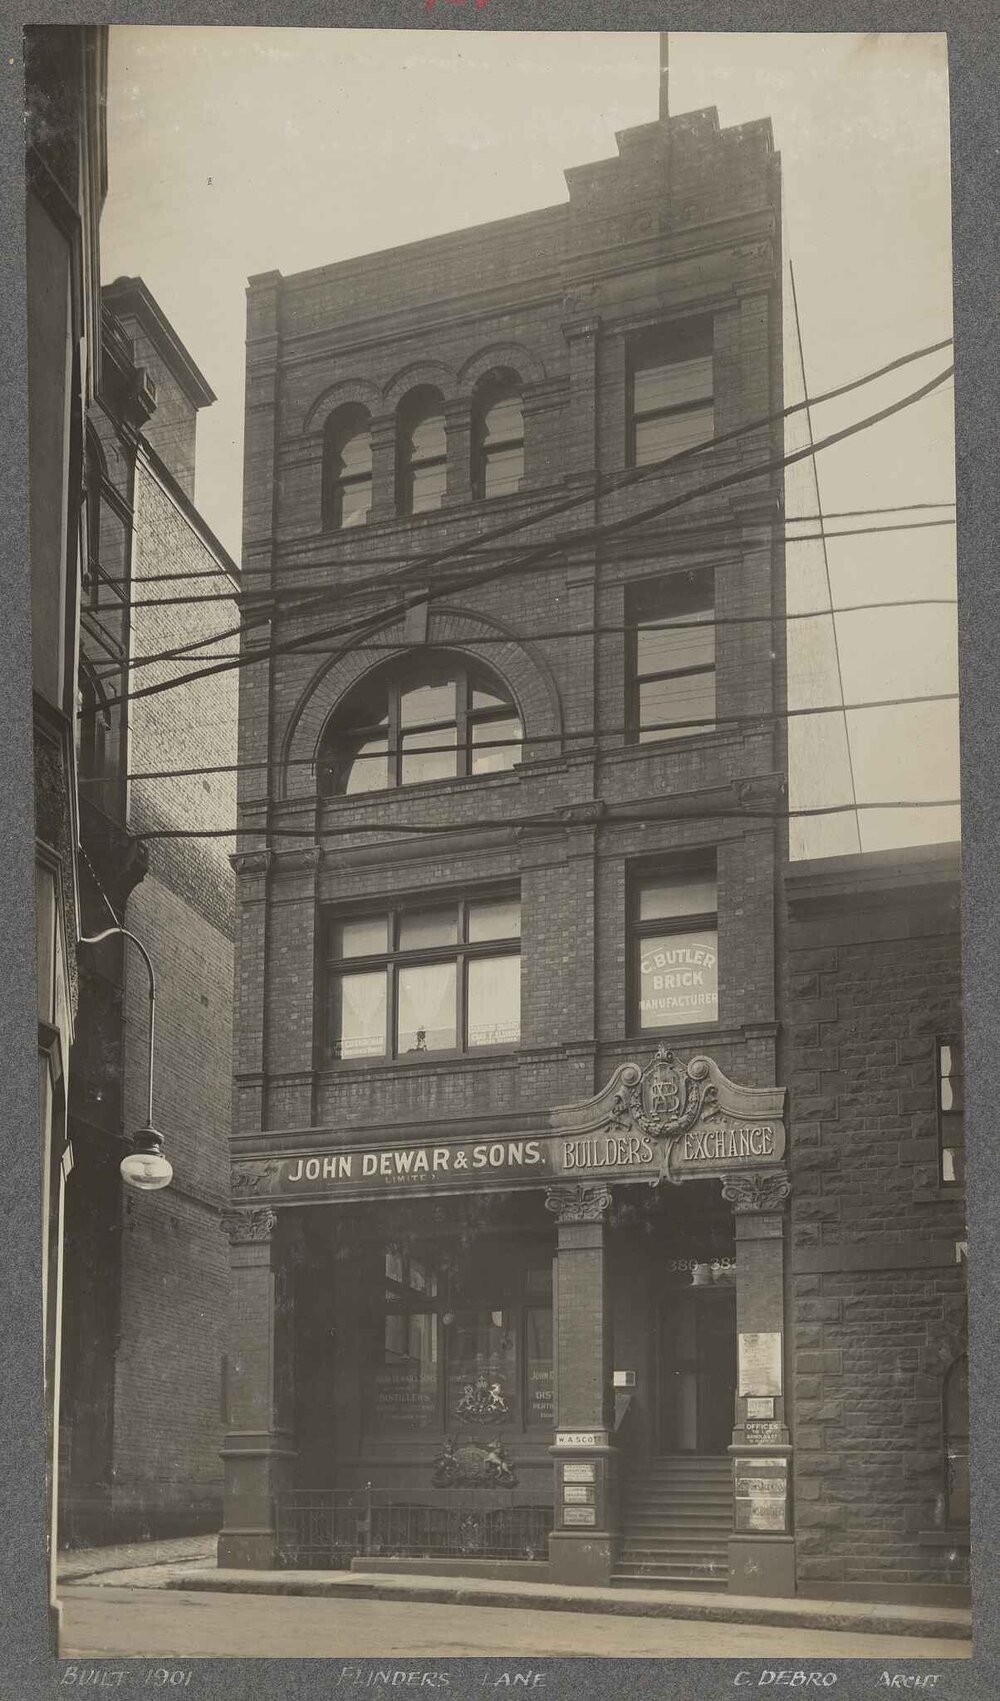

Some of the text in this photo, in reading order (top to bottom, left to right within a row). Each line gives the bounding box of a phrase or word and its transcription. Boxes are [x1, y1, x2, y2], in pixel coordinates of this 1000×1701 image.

[653, 970, 704, 990] BRICK
[639, 993, 718, 1011] MANUFACTURER
[563, 1126, 774, 1169] BUILDERS EXCHANGE
[289, 1156, 352, 1182] JOHN
[362, 1149, 450, 1177] DEWAR
[454, 1152, 468, 1169] &
[60, 1667, 192, 1687] BUILT 1901
[336, 1666, 547, 1689] FLINDERS LANE
[759, 1670, 838, 1687] DEBRO
